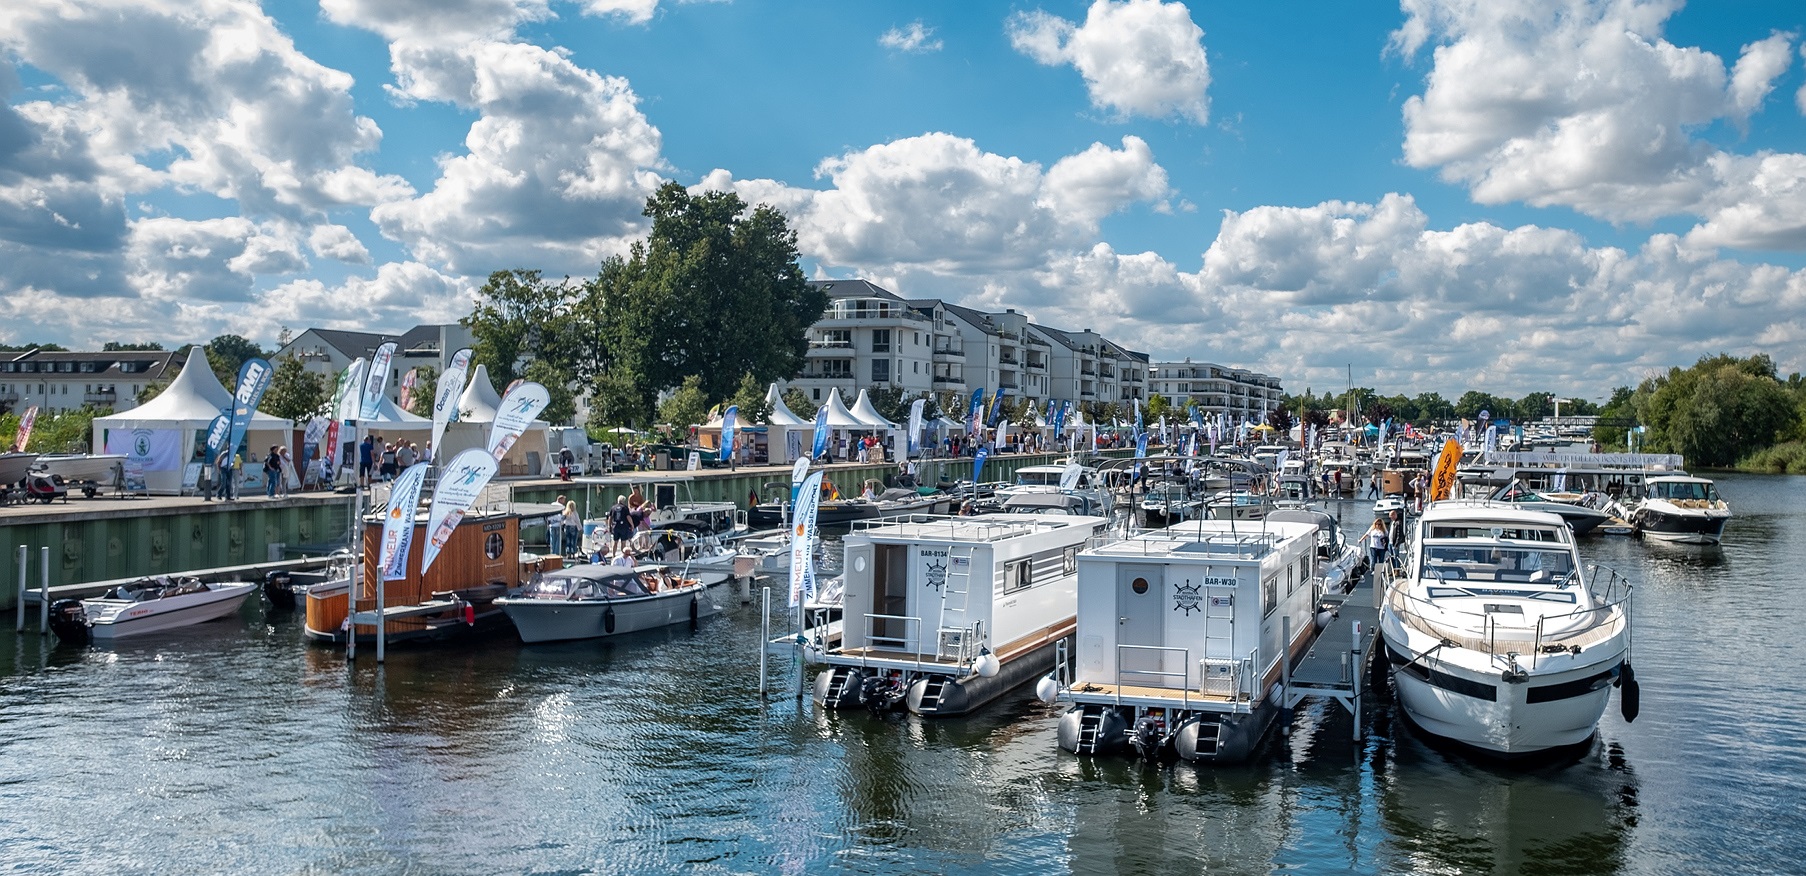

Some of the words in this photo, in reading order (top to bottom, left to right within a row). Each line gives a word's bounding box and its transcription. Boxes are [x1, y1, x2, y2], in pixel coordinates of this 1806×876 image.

[236, 362, 264, 405] awn
[436, 388, 451, 412] Ocean
[207, 415, 230, 450] awn
[395, 527, 410, 576] ZIMMERMANN
[404, 472, 421, 527] WASSERSPORT
[383, 529, 398, 577] PRIMEUR
[793, 549, 803, 602] PRIMEUR
[1205, 577, 1237, 586] BAR-W30
